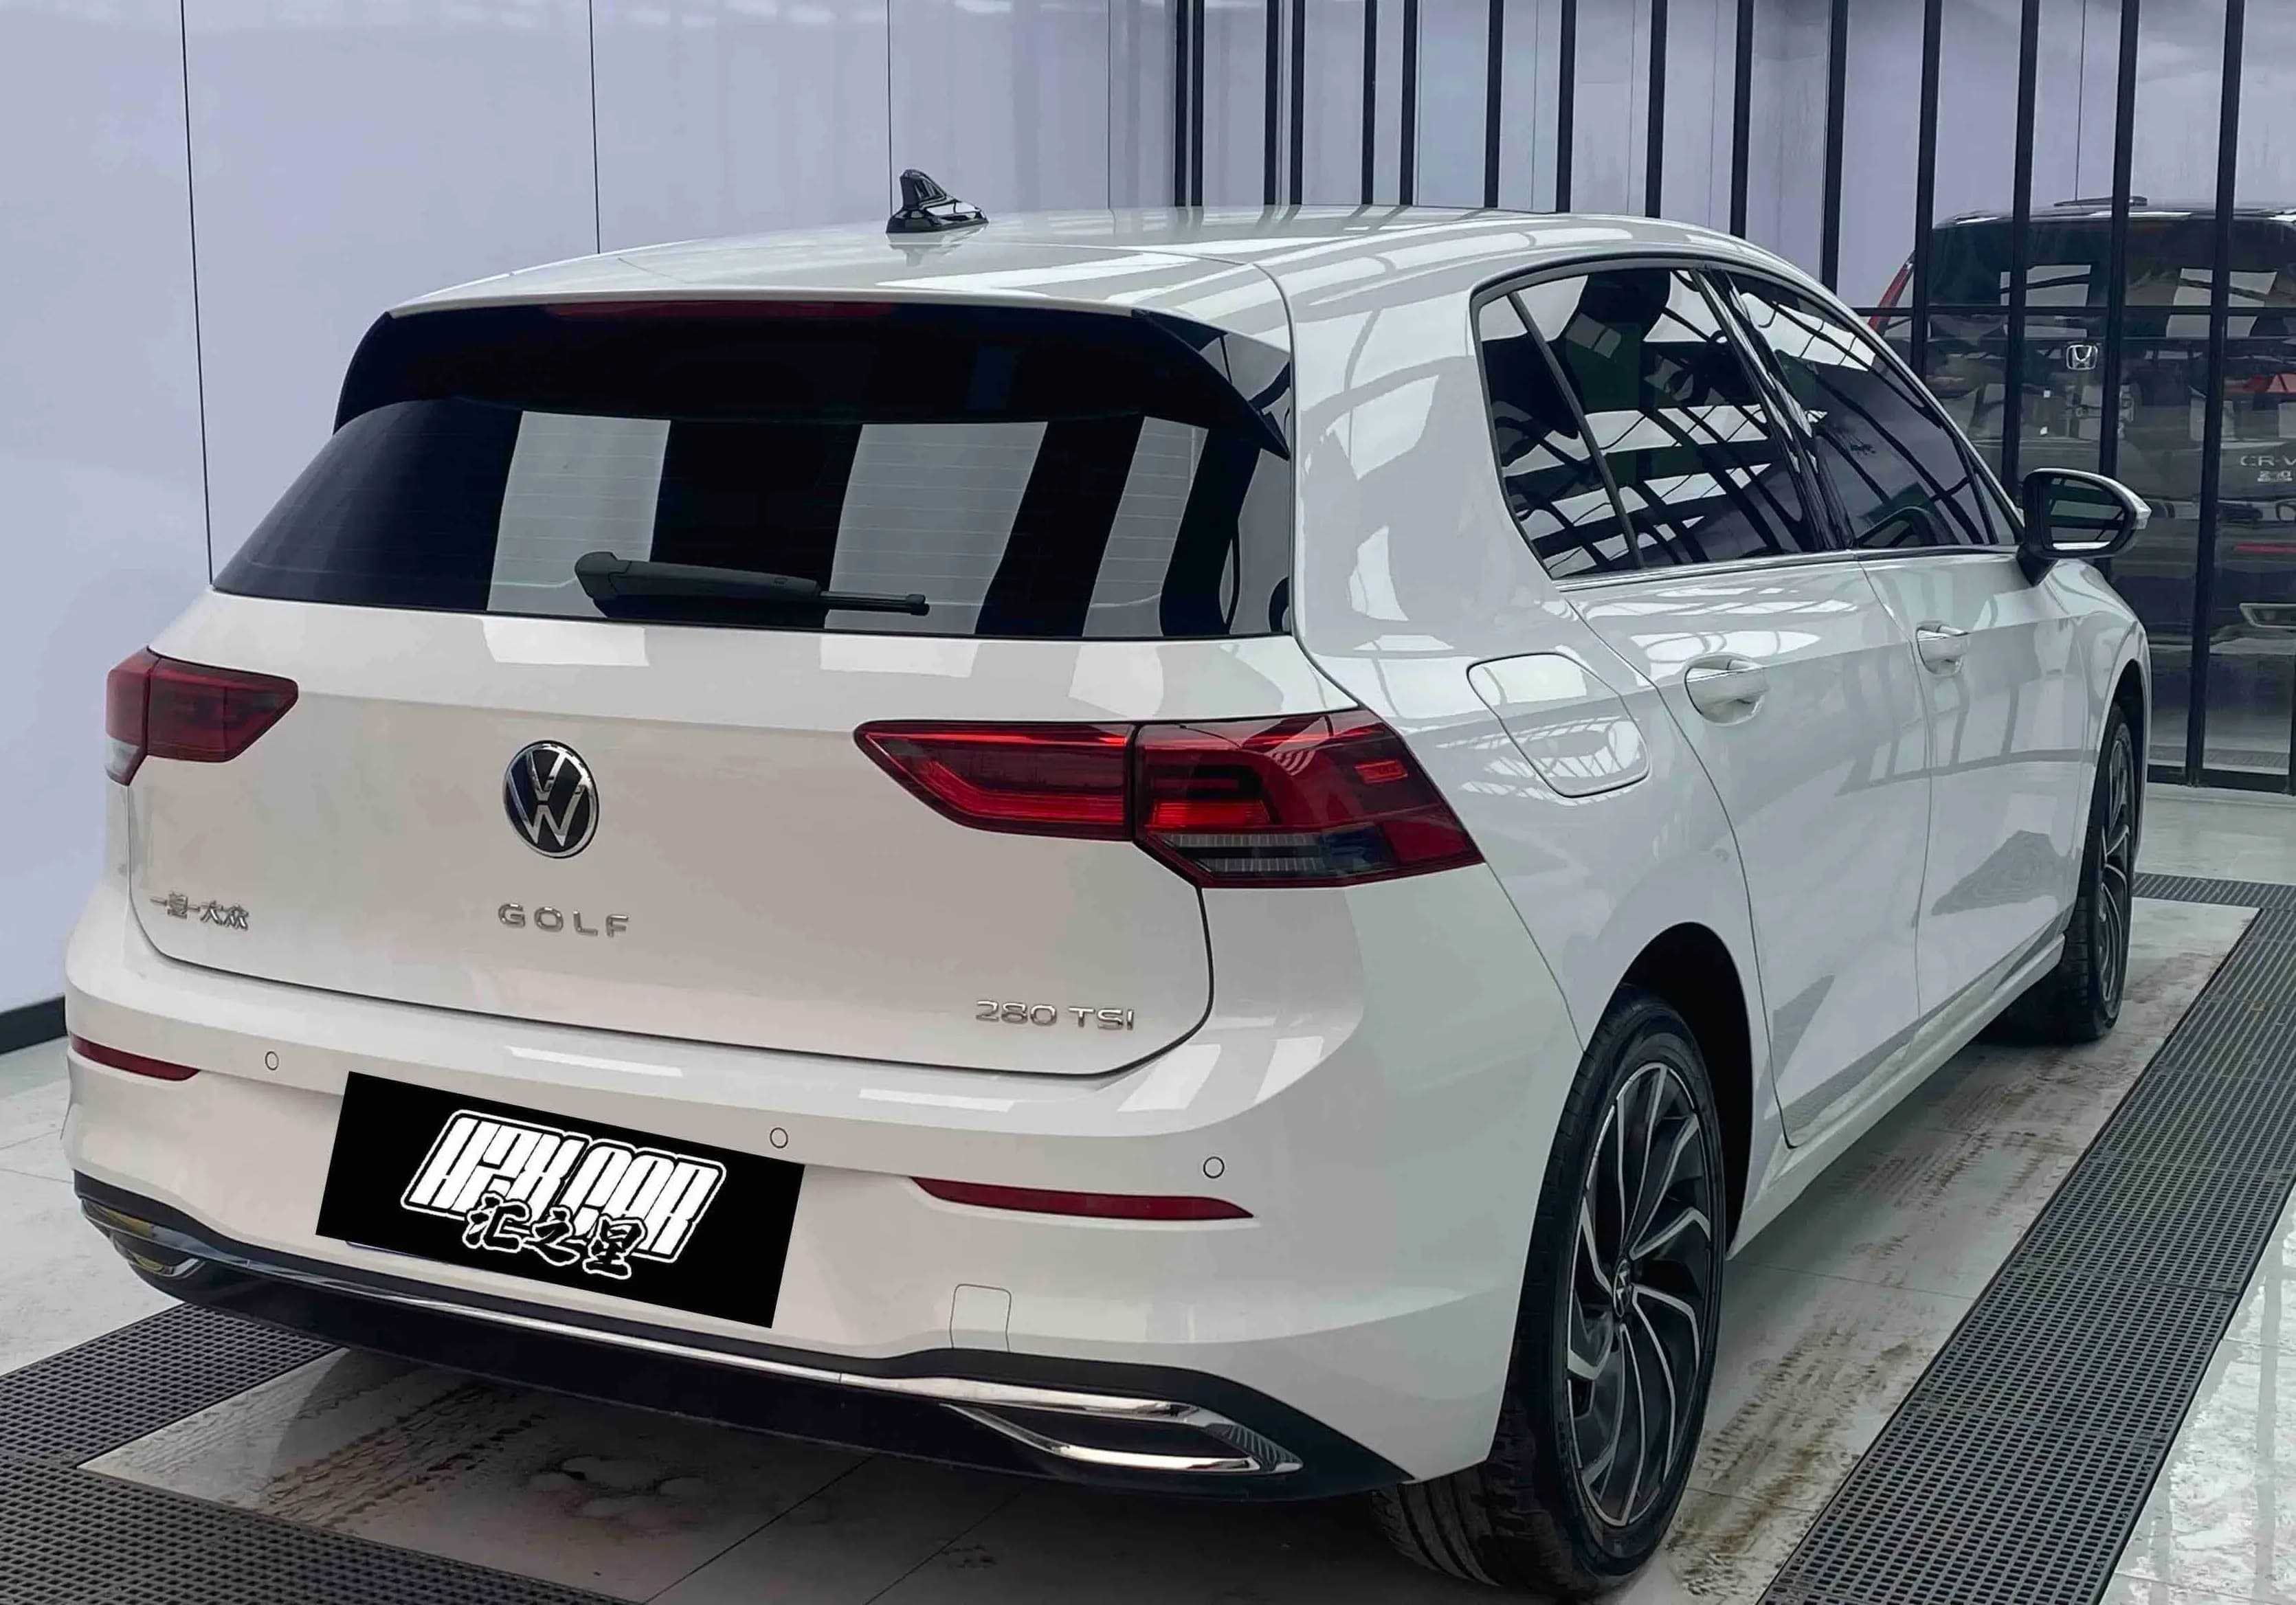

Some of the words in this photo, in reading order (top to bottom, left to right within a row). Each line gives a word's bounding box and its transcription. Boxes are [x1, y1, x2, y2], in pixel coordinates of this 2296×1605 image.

[2240, 455, 2296, 467] CR-V
[498, 902, 629, 937] GOLF
[975, 1000, 1057, 1026] 280
[1068, 1006, 1134, 1031] TSI
